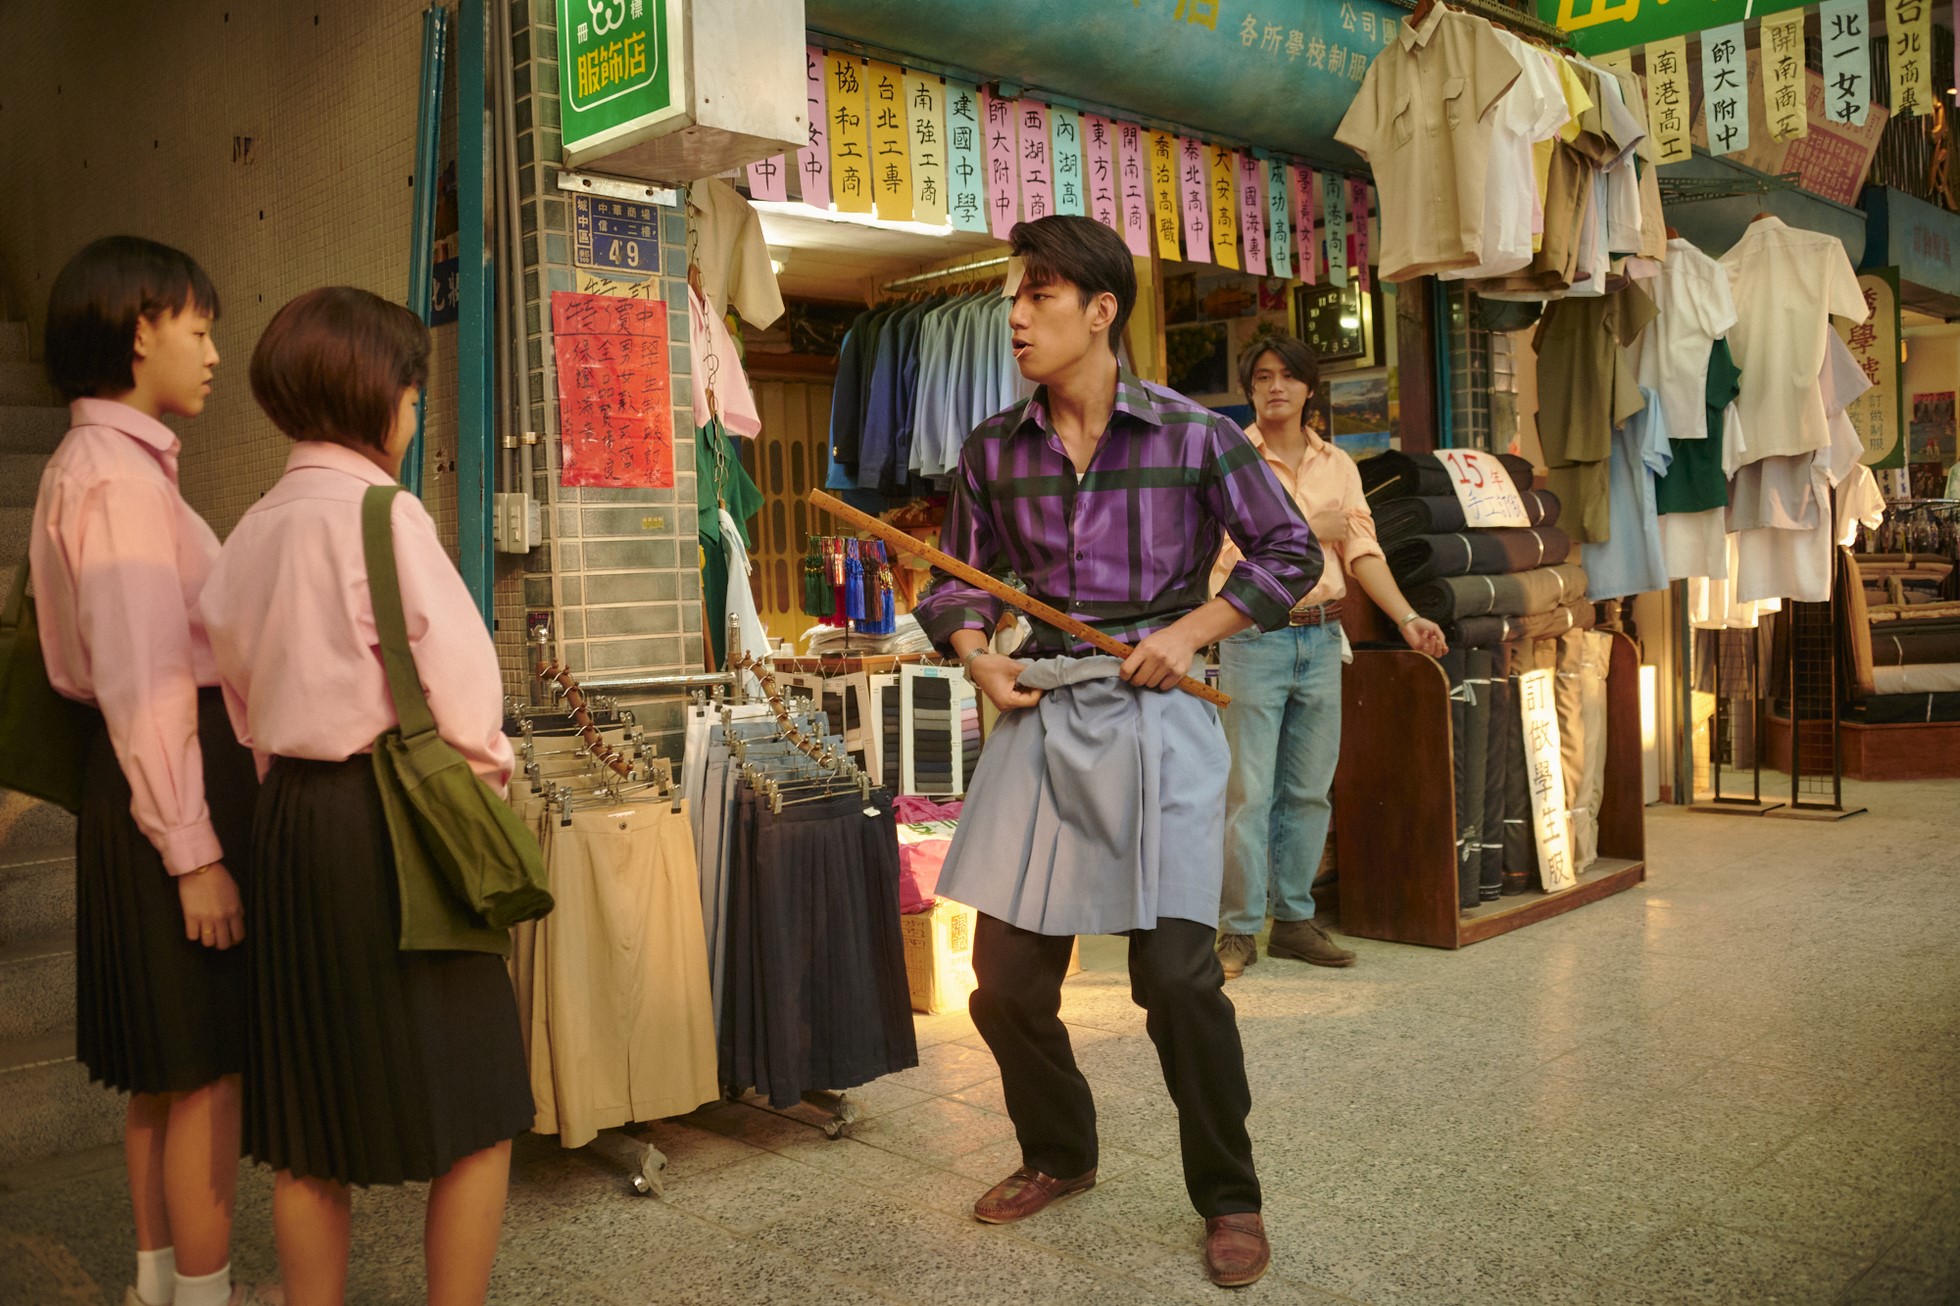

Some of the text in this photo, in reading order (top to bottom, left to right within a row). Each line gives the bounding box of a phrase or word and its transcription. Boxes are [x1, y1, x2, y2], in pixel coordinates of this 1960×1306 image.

[577, 30, 646, 98] 服飾店
[1240, 13, 1366, 82] 各所學校制服
[1711, 39, 1740, 151] 師大附中
[1772, 22, 1799, 138] 開南商工
[1830, 12, 1862, 122] 北一女中
[834, 60, 862, 197] 協和工商
[877, 76, 903, 194] 台北工專
[914, 82, 938, 206] 南強工商
[953, 91, 979, 223] 建國中學
[1653, 50, 1684, 158] 南港高工
[598, 203, 651, 221] 中華商場
[989, 99, 1010, 222] 師大附中
[1024, 111, 1047, 218] 西湖工商
[1122, 127, 1141, 230] 開南工商
[1155, 135, 1176, 245] 喬治高職
[1214, 147, 1233, 247] 大安高工
[1271, 160, 1287, 270] 成功高中
[577, 198, 590, 244] 城中區
[609, 239, 639, 267] 49
[1447, 453, 1485, 488] 15
[1525, 674, 1570, 886] 訂做學生服
